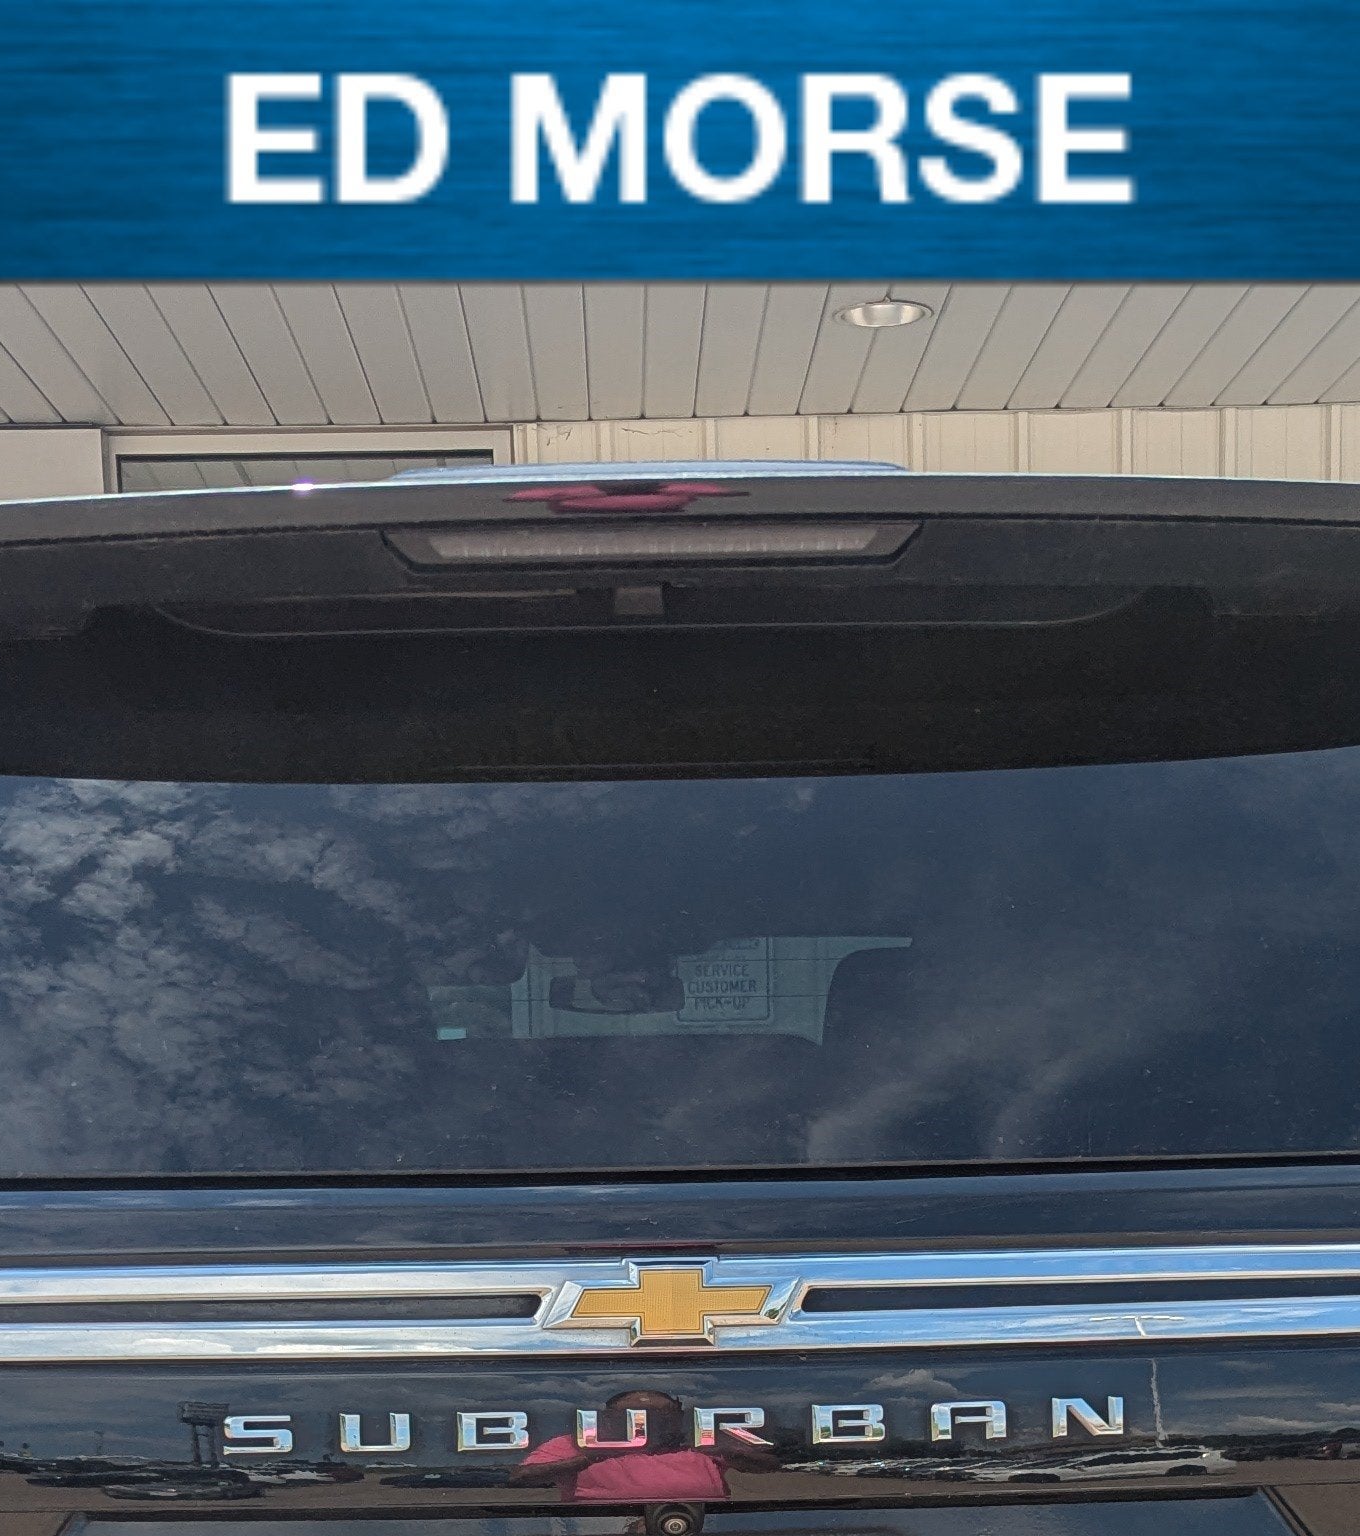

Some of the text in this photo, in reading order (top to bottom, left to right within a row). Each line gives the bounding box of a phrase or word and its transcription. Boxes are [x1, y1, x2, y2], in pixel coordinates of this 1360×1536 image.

[696, 963, 750, 977] SERVICE
[686, 979, 758, 994] CUSTOMER
[223, 1396, 1125, 1456] SUBURBAN
